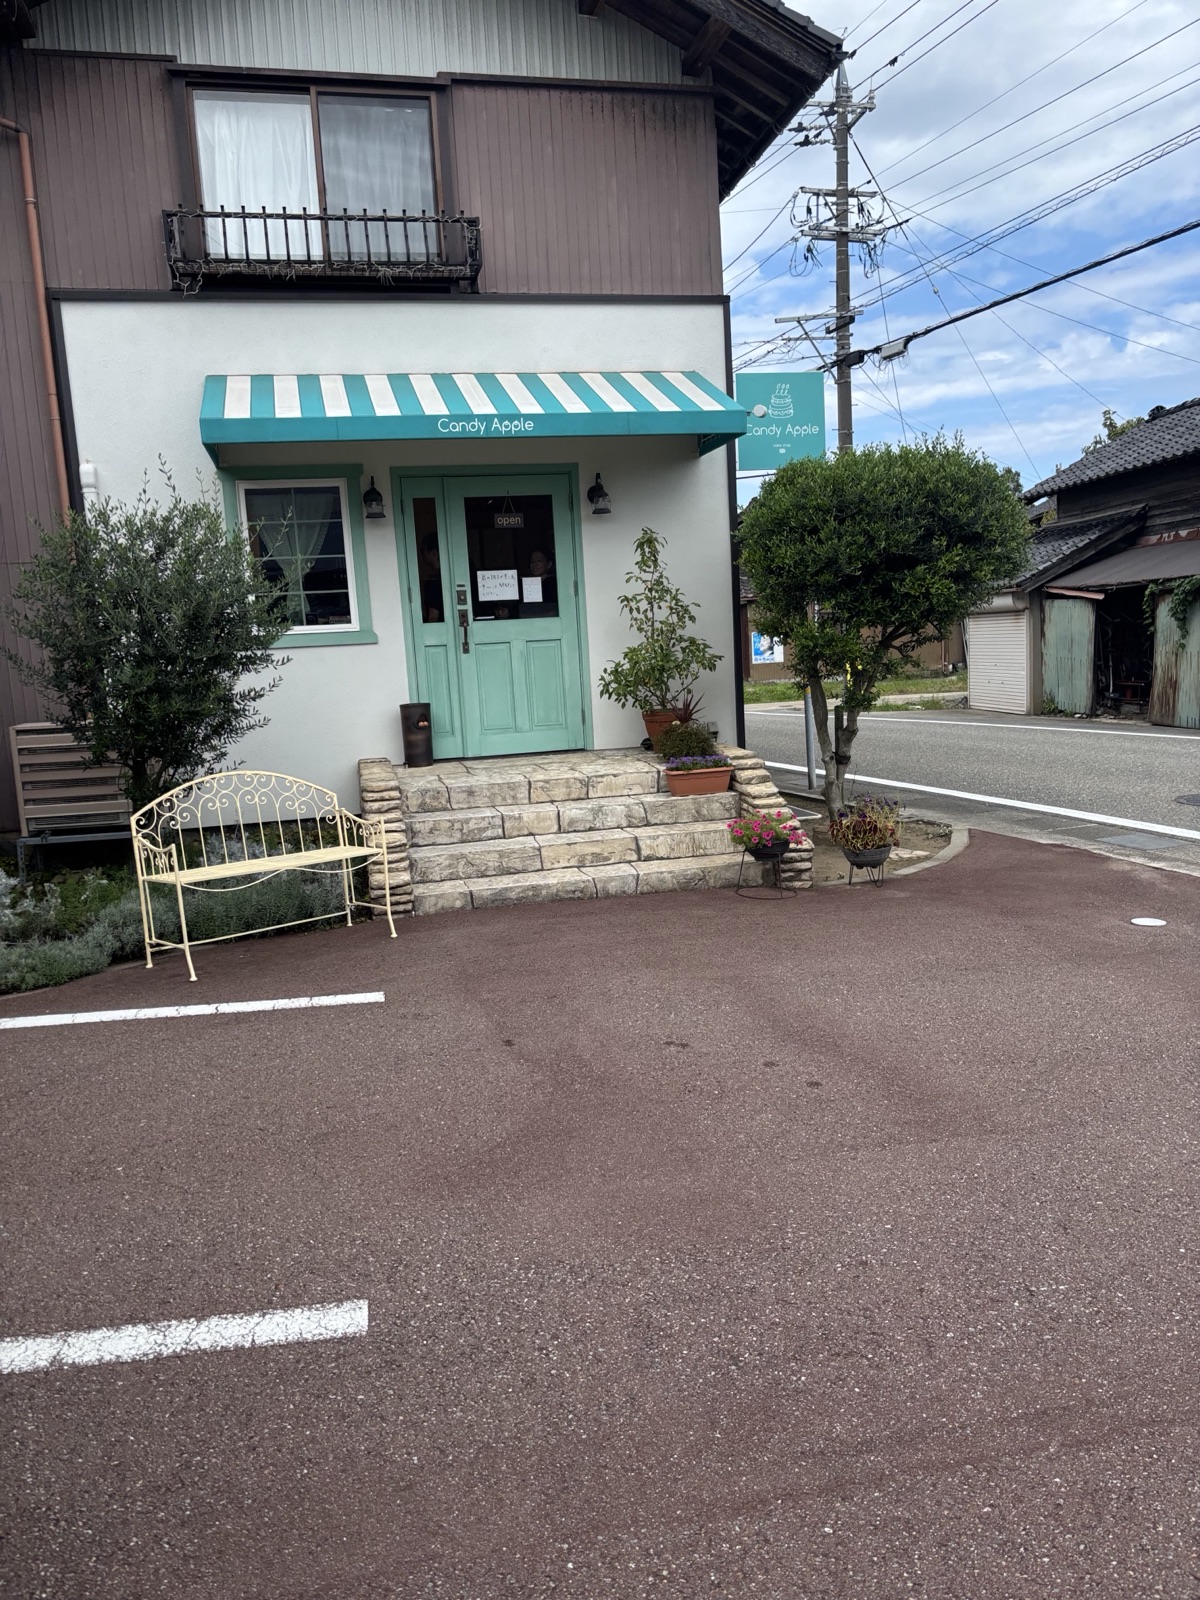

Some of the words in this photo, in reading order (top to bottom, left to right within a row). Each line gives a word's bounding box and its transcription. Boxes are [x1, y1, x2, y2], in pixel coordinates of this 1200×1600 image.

[437, 418, 486, 435] Candy
[491, 417, 534, 435] Apple
[786, 423, 819, 437] Apple
[497, 517, 521, 527] open
